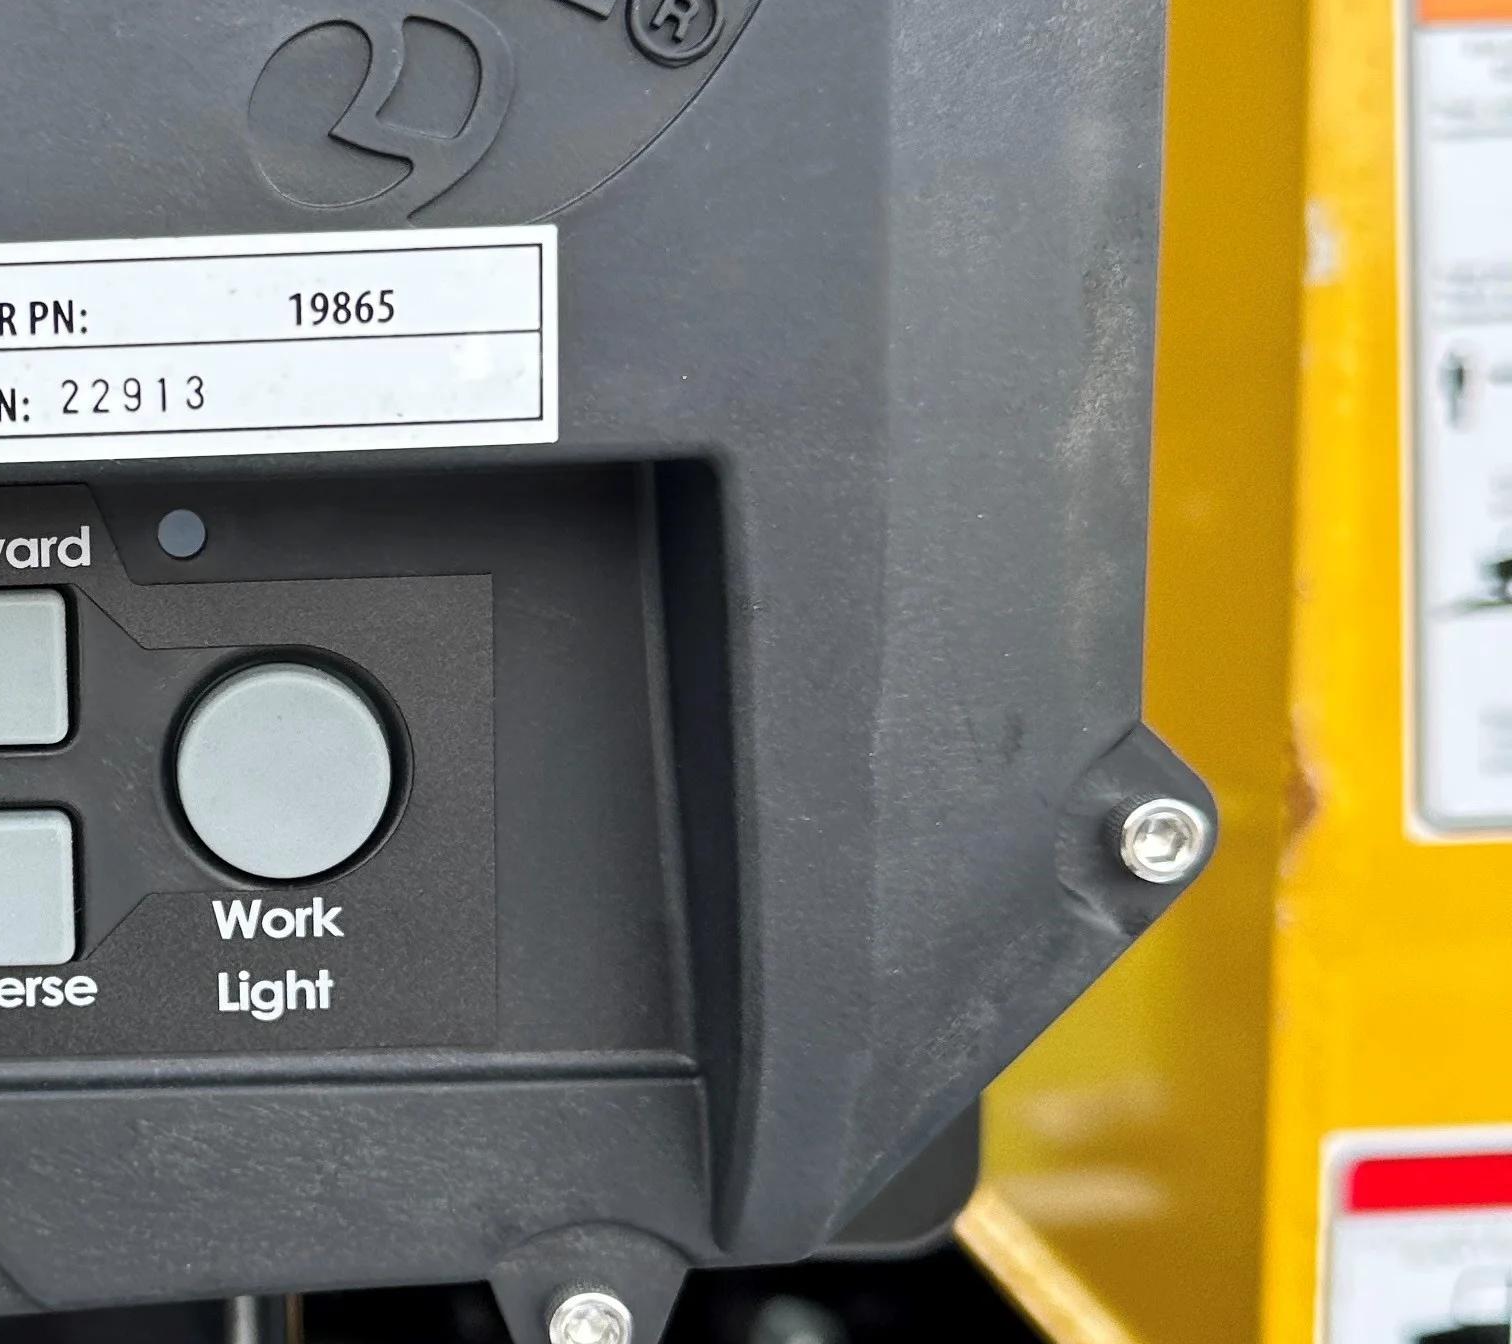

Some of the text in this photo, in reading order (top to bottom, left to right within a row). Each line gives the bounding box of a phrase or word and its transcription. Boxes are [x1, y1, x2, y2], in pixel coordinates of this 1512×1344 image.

[29, 300, 89, 336] PN:
[288, 290, 396, 326] 19865
[61, 375, 206, 415] 22913
[212, 897, 344, 940] Work
[217, 969, 334, 1022] Light
